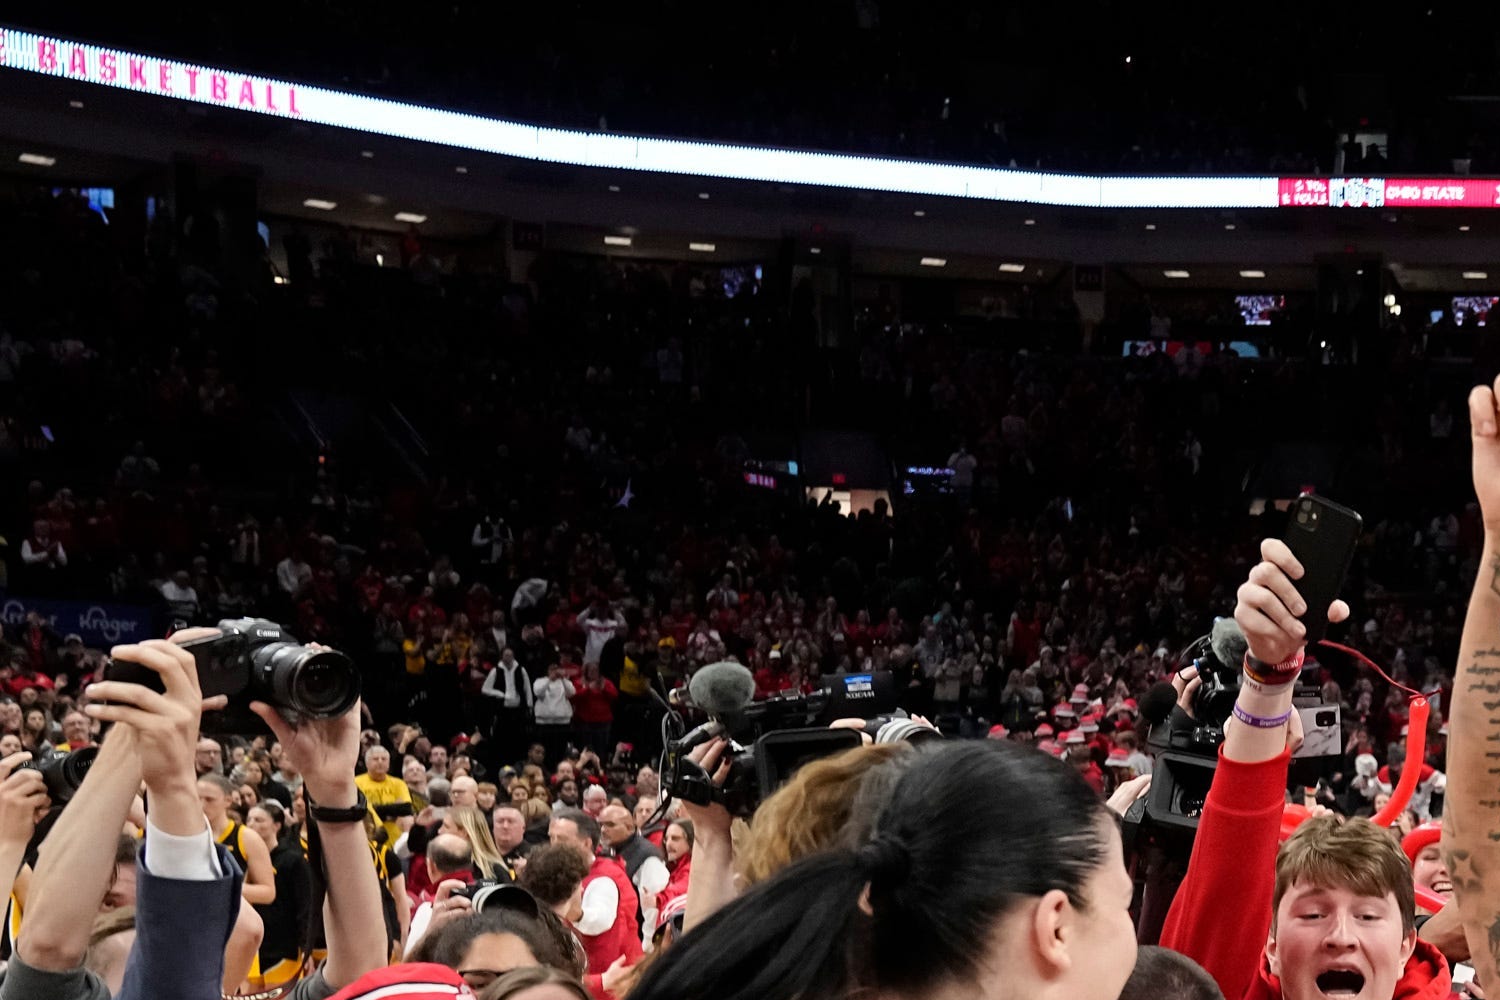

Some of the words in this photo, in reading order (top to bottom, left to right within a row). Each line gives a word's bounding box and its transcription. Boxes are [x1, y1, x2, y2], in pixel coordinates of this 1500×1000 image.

[37, 38, 300, 115] BASKETBALL
[1421, 185, 1466, 201] STATE
[79, 605, 138, 642] Kroger
[256, 628, 281, 638] Canon
